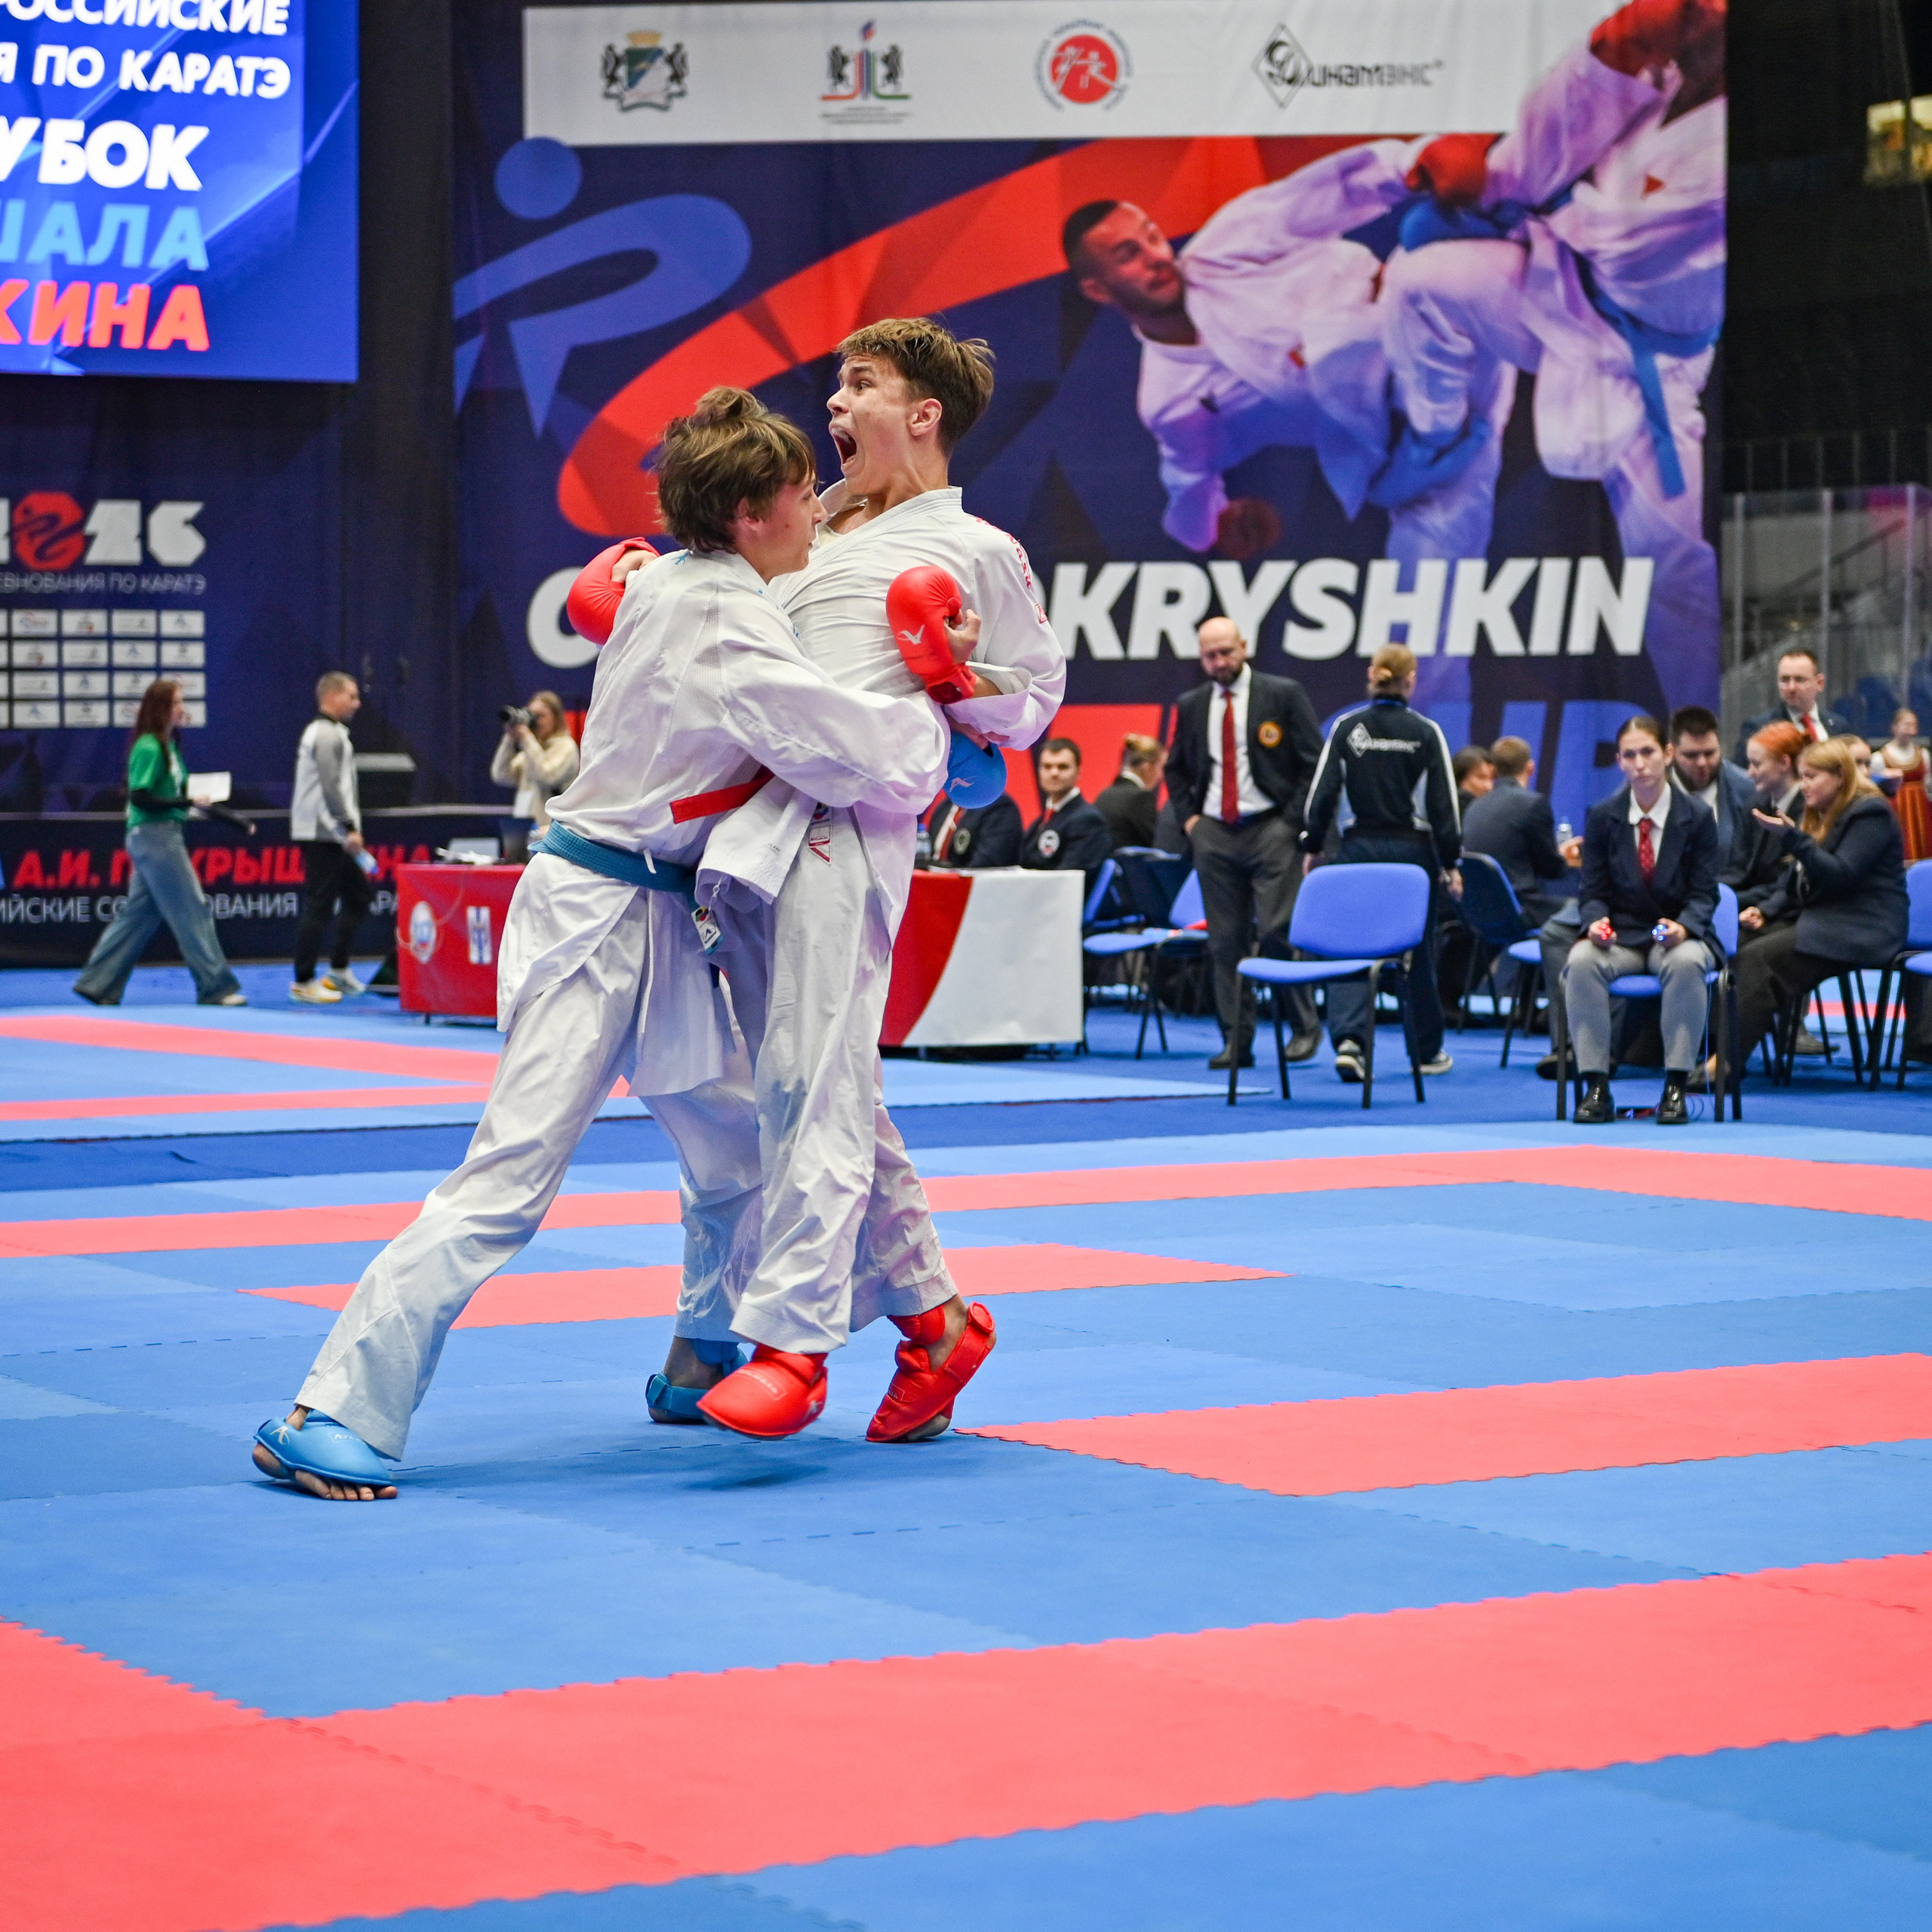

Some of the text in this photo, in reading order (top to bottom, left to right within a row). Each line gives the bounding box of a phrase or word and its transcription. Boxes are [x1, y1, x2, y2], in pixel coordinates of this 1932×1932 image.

[0, 0, 291, 36] ОССИЙСКИЕ
[32, 44, 105, 89] ПО
[118, 48, 291, 100] КАРАТЭ
[109, 572, 137, 594] ПО
[140, 573, 207, 596] КАРАТЭ
[1032, 555, 1655, 660] KRYSHKIN
[13, 848, 100, 889] А.И.
[0, 894, 91, 924] ЙСКИЕ
